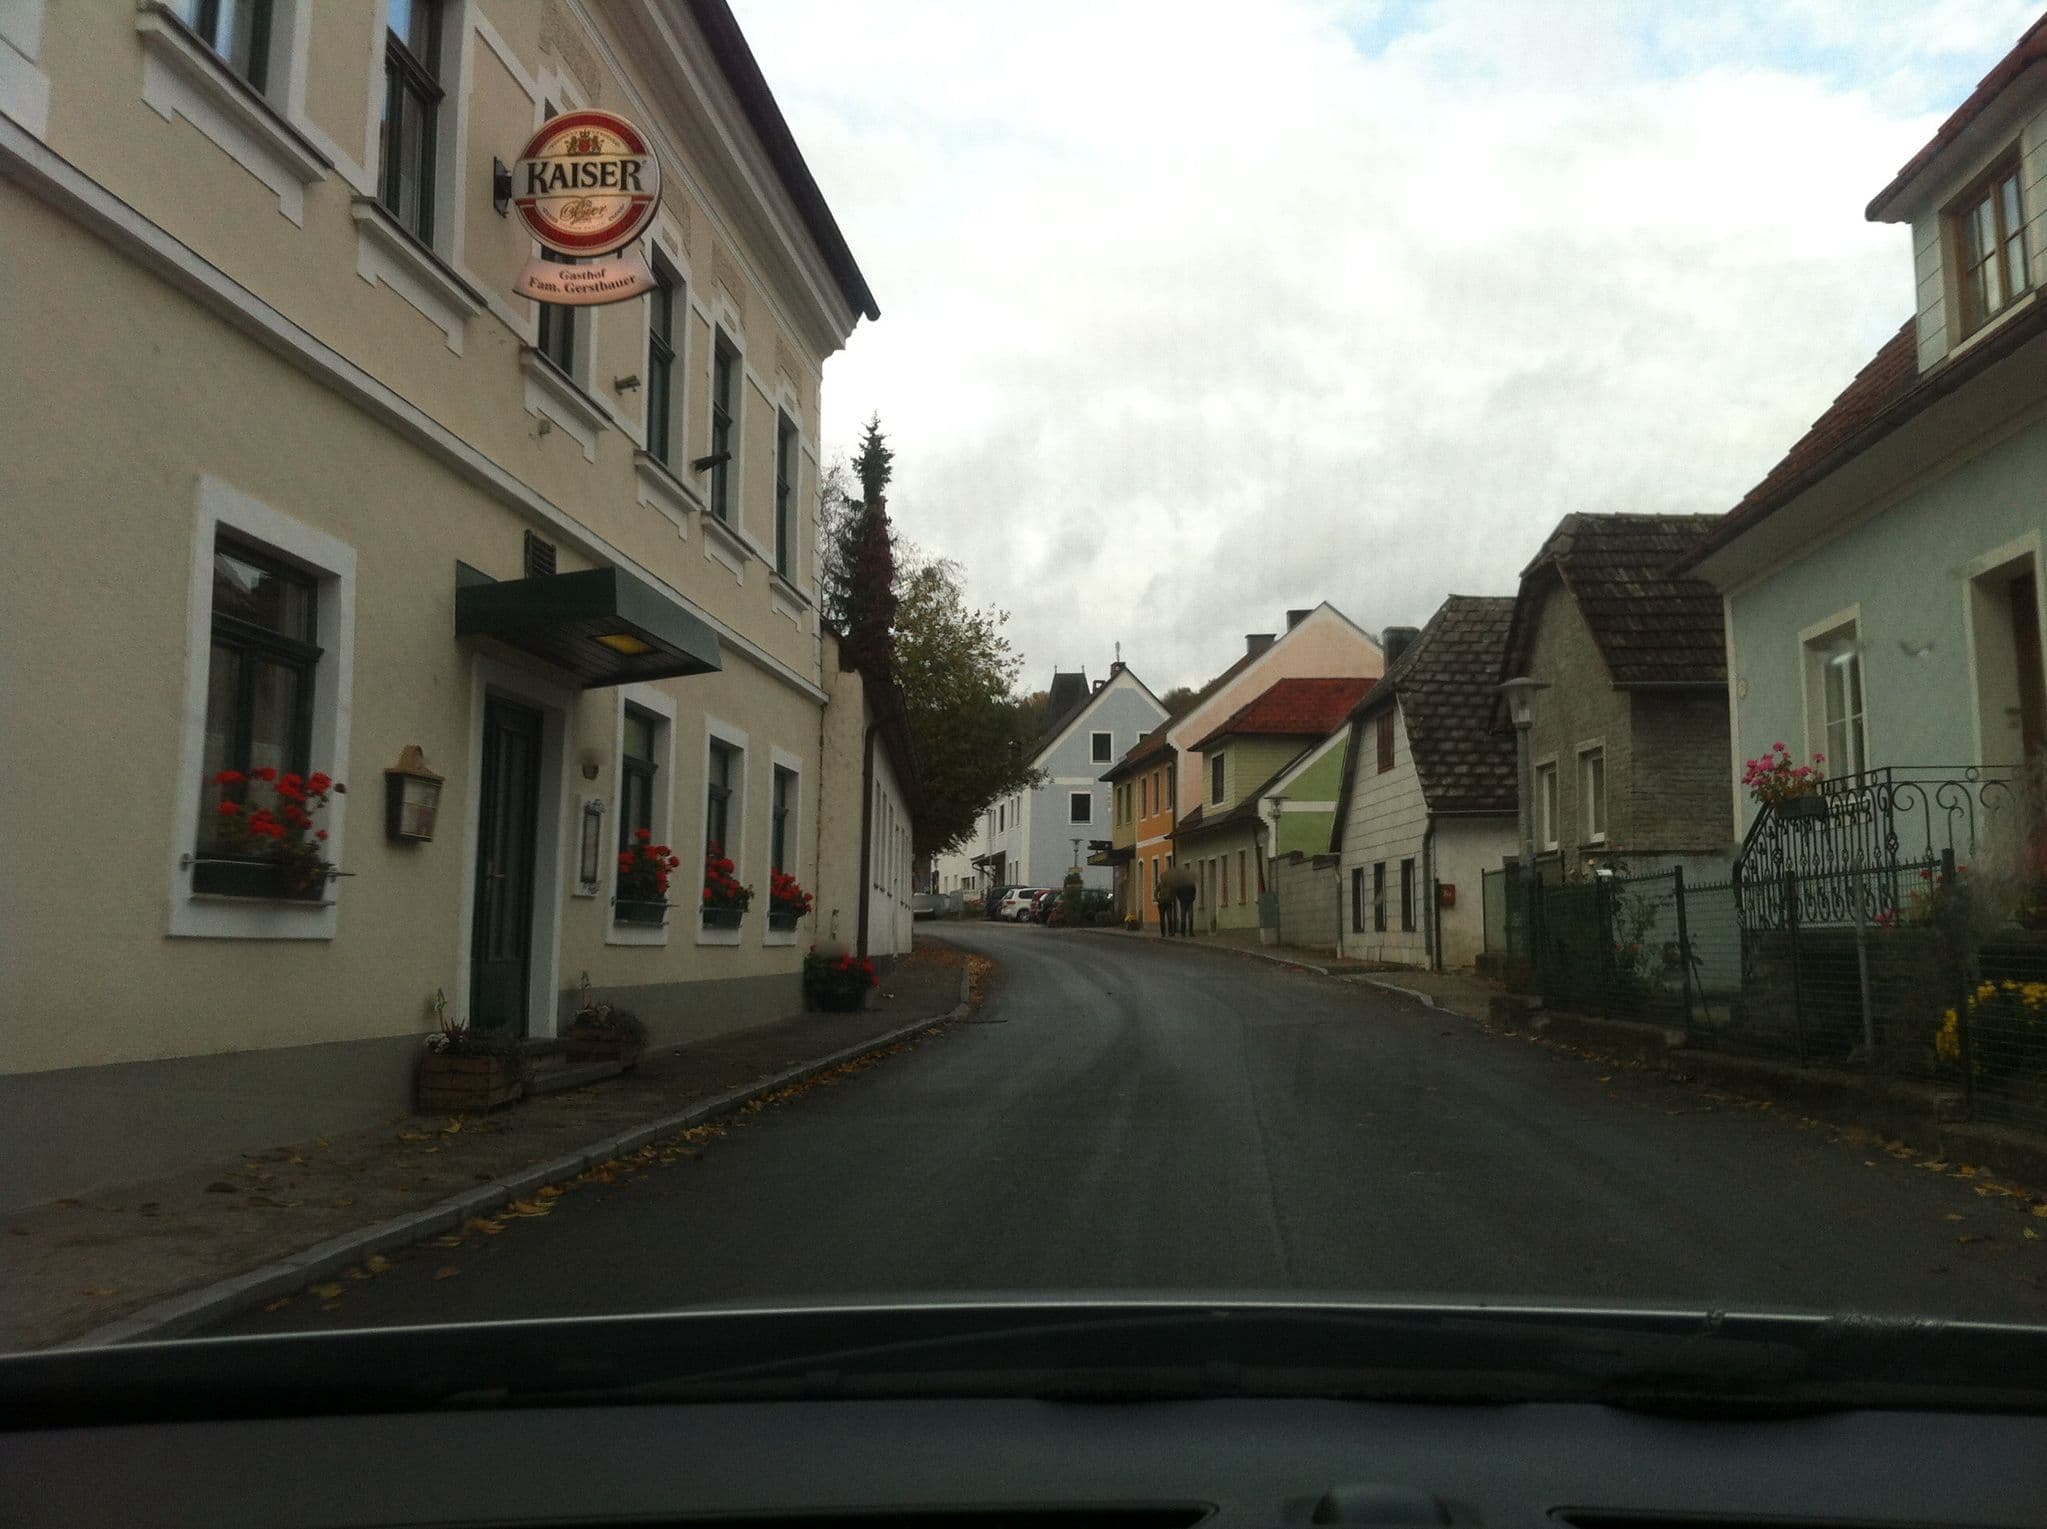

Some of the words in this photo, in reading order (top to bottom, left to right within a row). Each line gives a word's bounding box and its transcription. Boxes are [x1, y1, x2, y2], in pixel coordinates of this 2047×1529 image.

[526, 159, 644, 195] KAISER
[559, 268, 606, 281] Gasthof
[528, 275, 561, 293] Fam.
